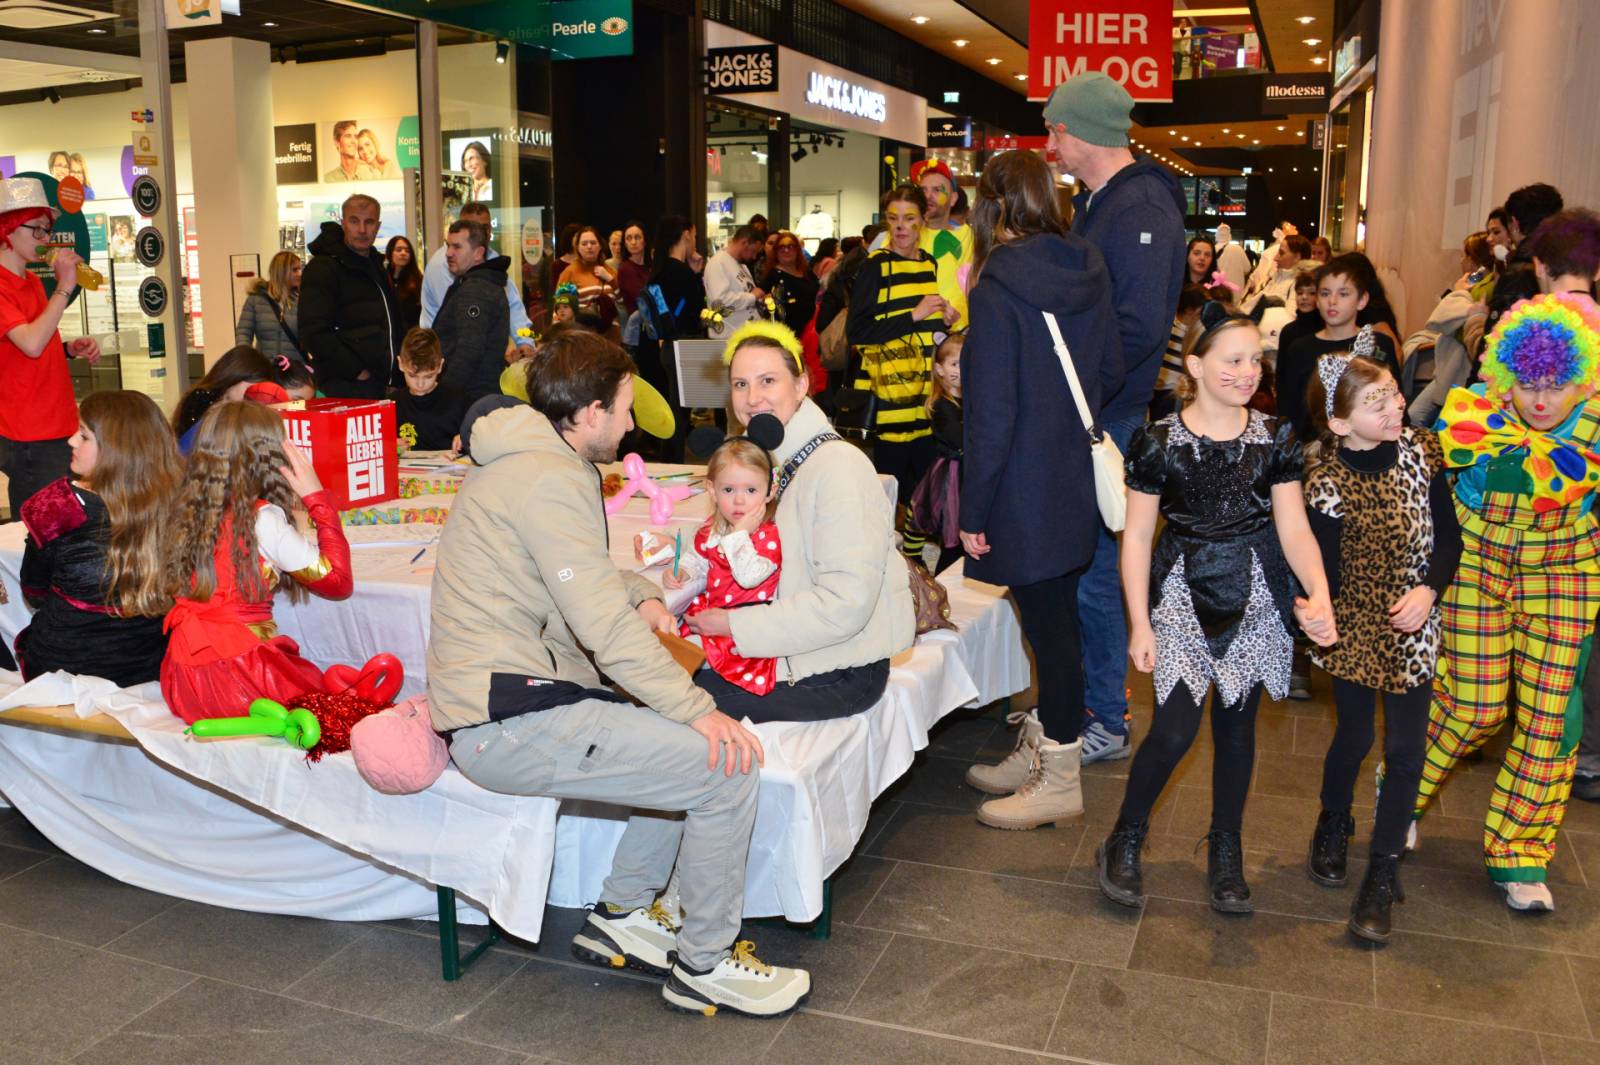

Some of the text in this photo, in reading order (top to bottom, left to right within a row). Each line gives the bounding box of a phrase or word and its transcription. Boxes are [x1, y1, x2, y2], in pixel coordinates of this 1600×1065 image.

[552, 20, 596, 37] Pearle
[1056, 12, 1148, 44] HIER
[710, 53, 772, 72] JACK&
[1043, 56, 1159, 88] IM OG
[710, 69, 772, 88] JONES
[290, 141, 312, 153] Fertig
[283, 419, 312, 446] LLE
[346, 413, 382, 445] ALLE
[346, 440, 383, 463] LIEBEN
